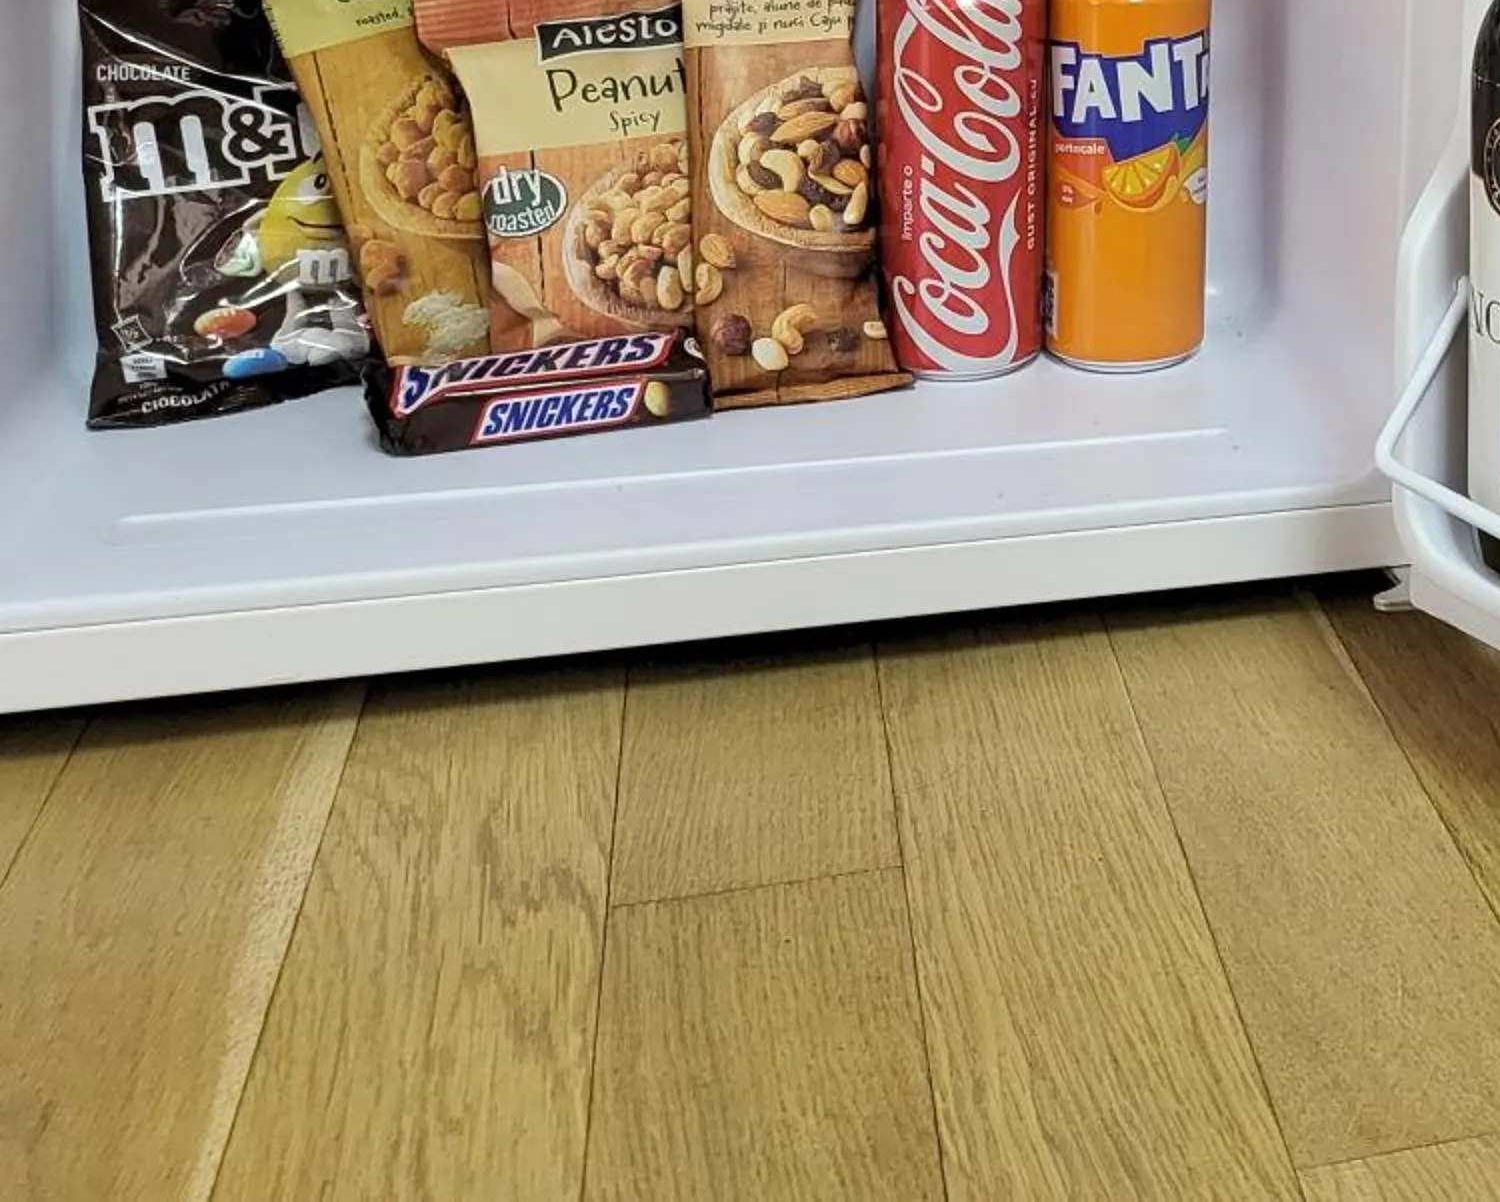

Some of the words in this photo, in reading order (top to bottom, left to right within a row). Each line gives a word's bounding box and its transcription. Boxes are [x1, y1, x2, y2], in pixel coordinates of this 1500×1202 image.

[551, 14, 679, 49] Alesto
[96, 64, 192, 82] CHOCOLATE
[609, 109, 661, 136] Spicy
[491, 165, 542, 206] dry
[486, 199, 556, 232] roasted
[402, 334, 662, 409] SNICKERS
[482, 386, 635, 437] SNICKERS
